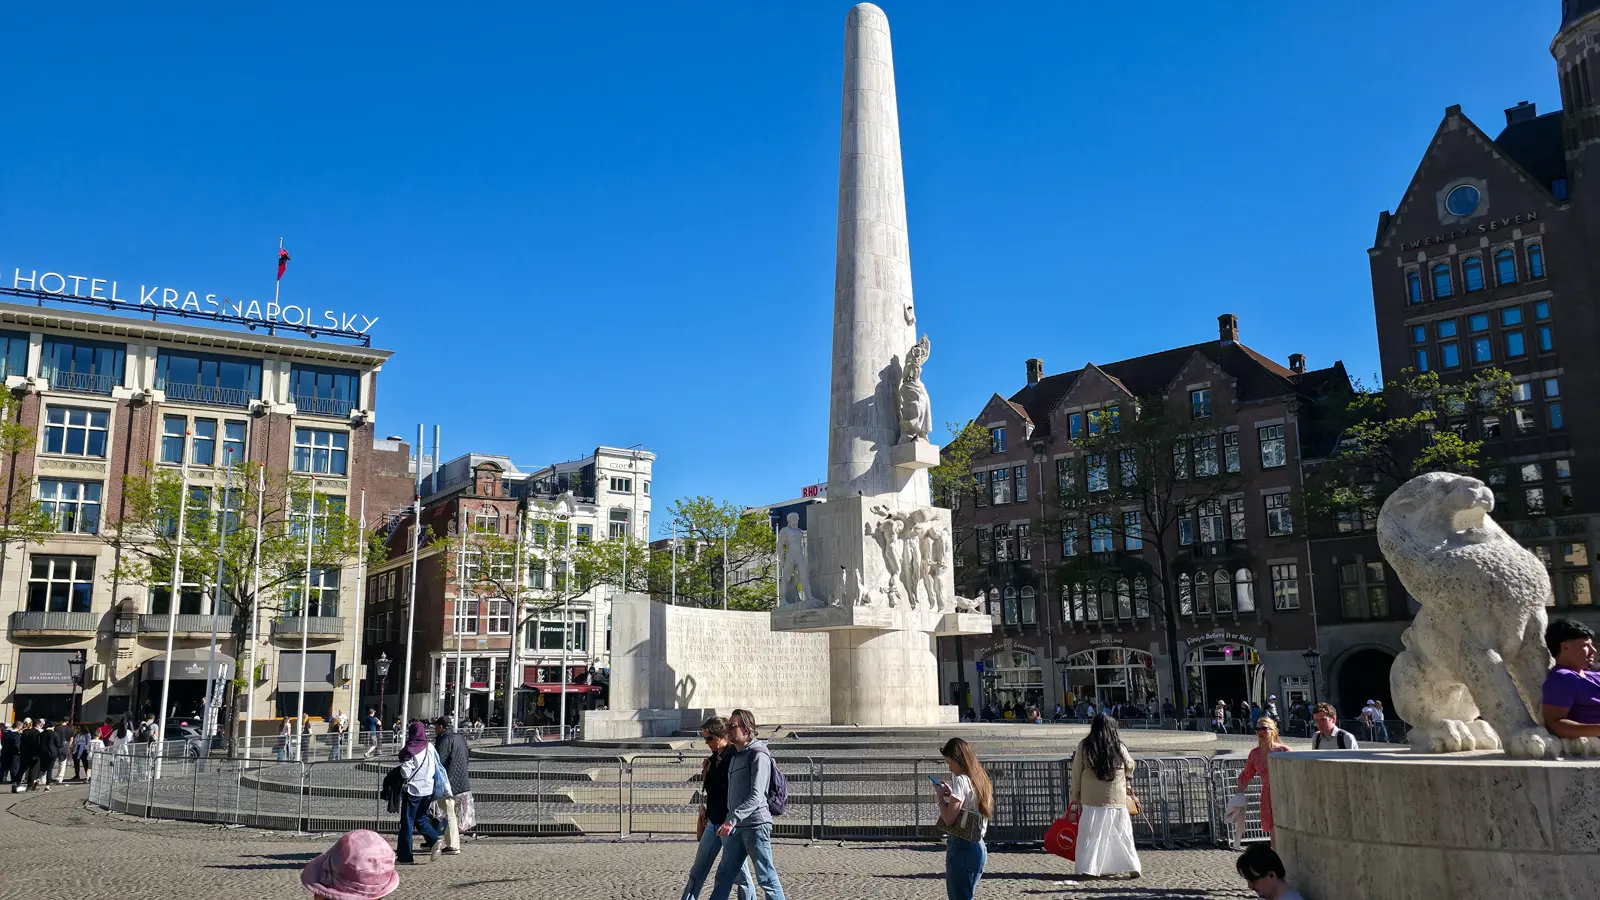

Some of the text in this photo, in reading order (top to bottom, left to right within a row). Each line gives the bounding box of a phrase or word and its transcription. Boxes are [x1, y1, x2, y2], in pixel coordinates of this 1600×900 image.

[1398, 211, 1538, 251] TWENTY SEVEN
[14, 268, 380, 334] HOTEL KRASNAPOLSKY
[1060, 491, 1133, 508] RIPLEY'S
